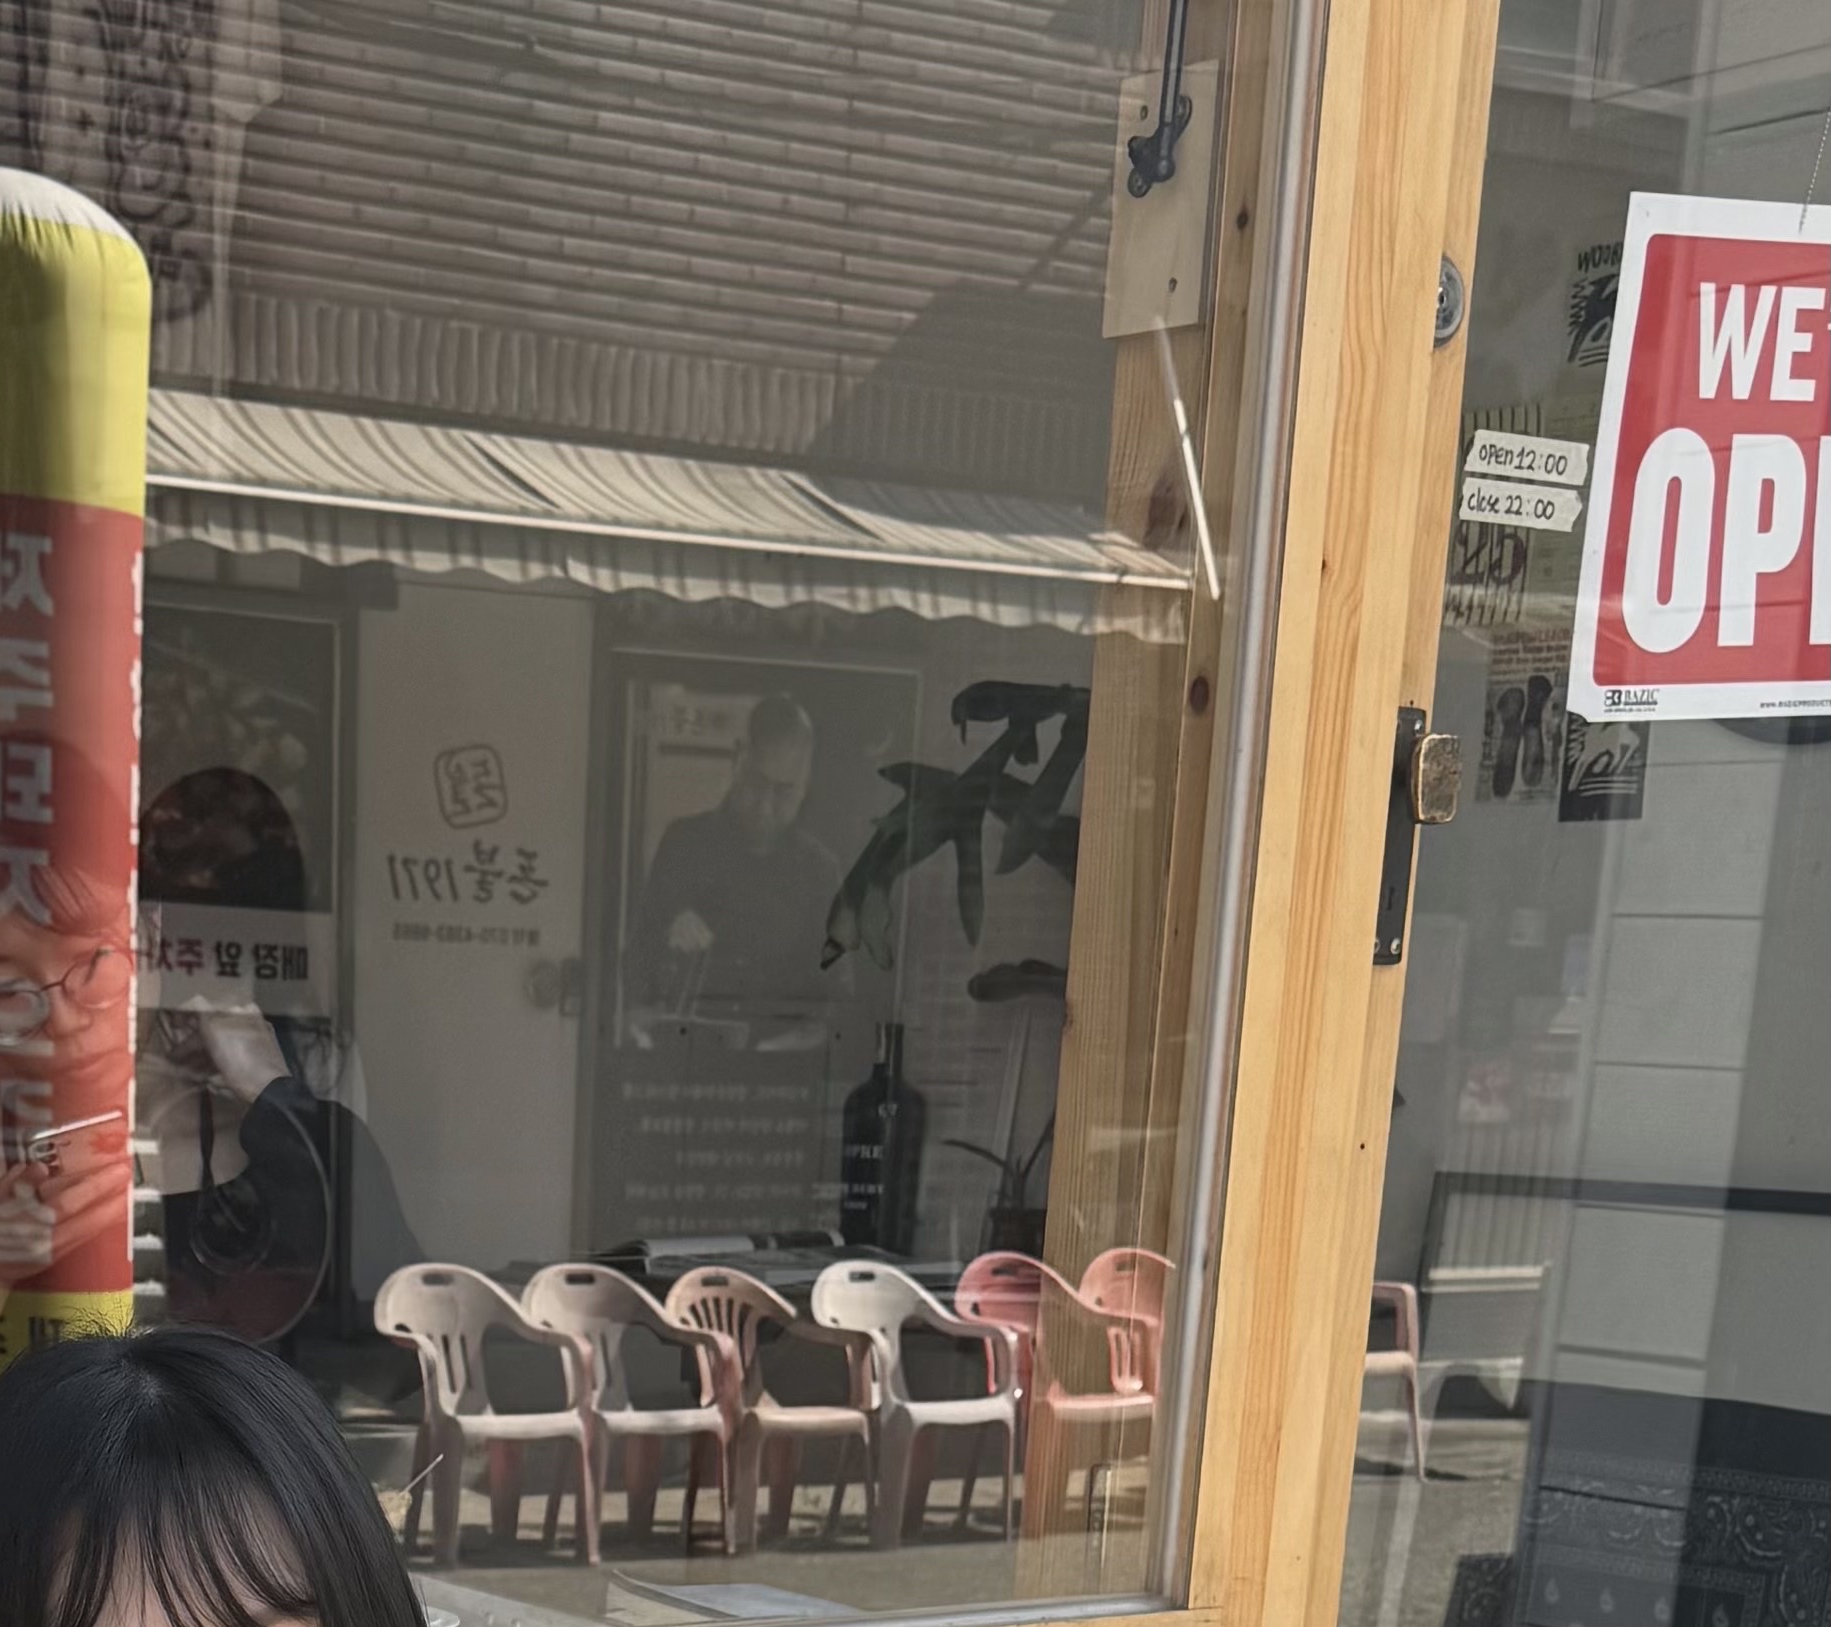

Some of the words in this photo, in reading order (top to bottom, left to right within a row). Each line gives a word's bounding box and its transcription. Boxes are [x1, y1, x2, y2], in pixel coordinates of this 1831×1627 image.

[1467, 487, 1501, 515] close
[1504, 494, 1556, 520] 22:00
[1621, 426, 1831, 654] OP
